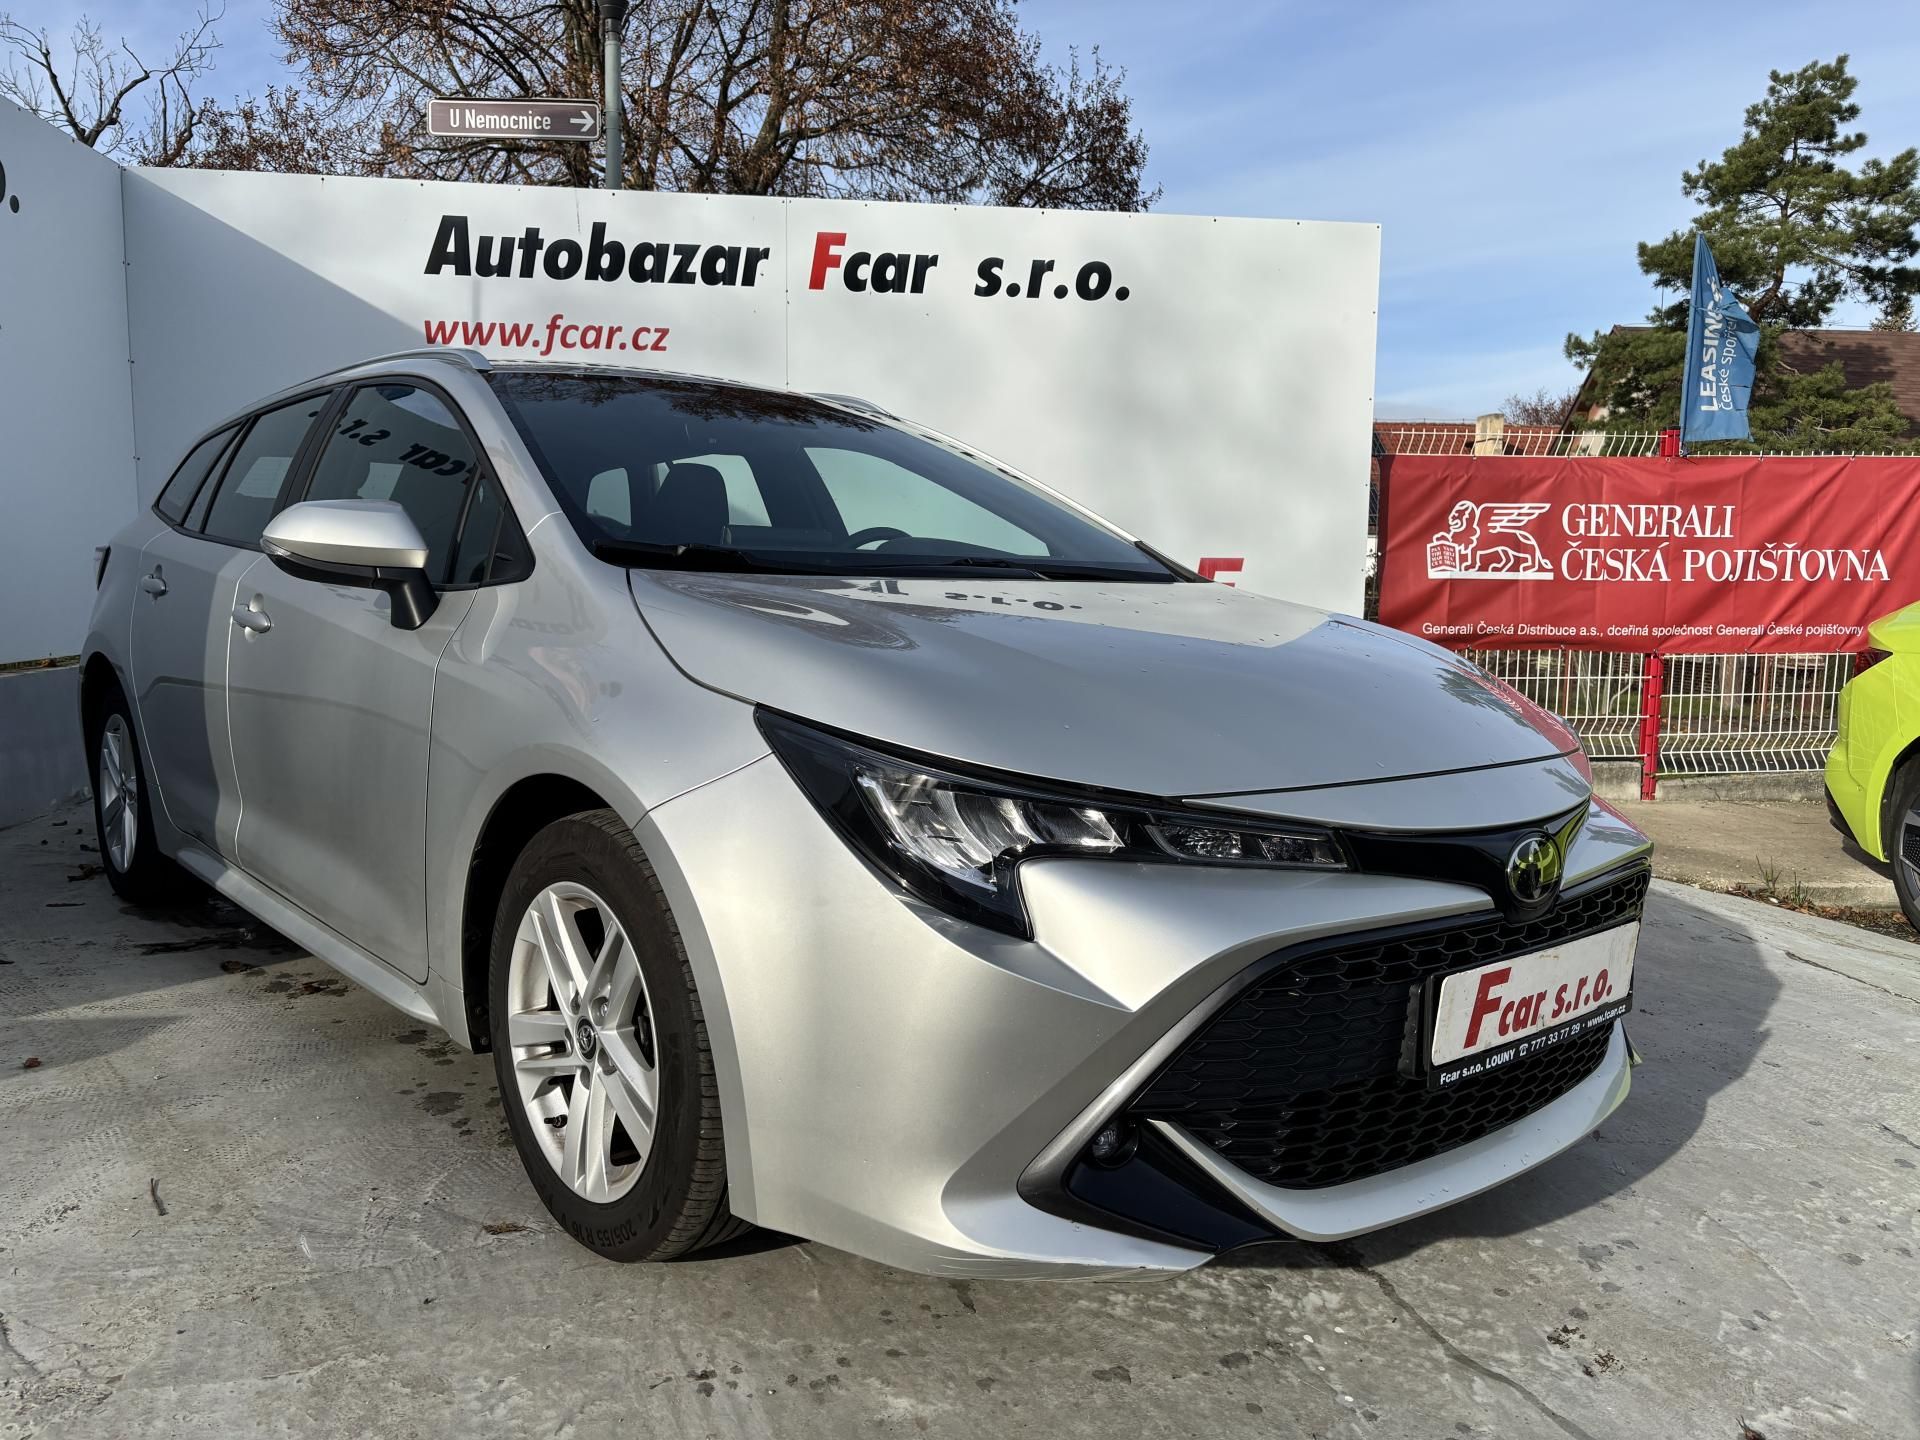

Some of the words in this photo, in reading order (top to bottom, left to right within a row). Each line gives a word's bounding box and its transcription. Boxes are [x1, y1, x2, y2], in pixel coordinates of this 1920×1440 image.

[449, 108, 460, 128] U
[465, 109, 551, 130] Nemocnice
[423, 214, 770, 287] Autobazar
[808, 231, 939, 295] Fcar
[974, 255, 1131, 302] s.r.o.
[423, 313, 670, 357] www.fcar.cz
[1700, 300, 1724, 412] LEASING
[1561, 502, 1736, 538] GENERALI
[1560, 540, 1672, 582] ČESKÁ
[1681, 541, 1891, 582] POJIŠŤOVNA
[1422, 622, 1473, 635] Generali
[1476, 620, 1514, 635] Česká
[1517, 623, 1576, 636] Distribuce
[1579, 625, 1604, 638] a.s.,
[1607, 623, 1649, 636] dceřiná
[1651, 624, 1713, 639] společnost
[1716, 623, 1764, 636] Generali
[1766, 621, 1803, 635] České
[1805, 623, 1864, 638] pojišťovny
[1463, 966, 1548, 1050] Fcar
[1551, 968, 1613, 1019] s.r.o.
[1440, 1070, 1461, 1086] Fcar
[1462, 1063, 1484, 1078] s.r.o.
[1485, 1048, 1516, 1070] LOUNY
[1530, 1037, 1547, 1052] 777
[1547, 1031, 1559, 1046] 33
[1560, 1026, 1570, 1040] 77
[1570, 1022, 1581, 1036] 29
[1587, 1004, 1627, 1028] www.fcar.cz
